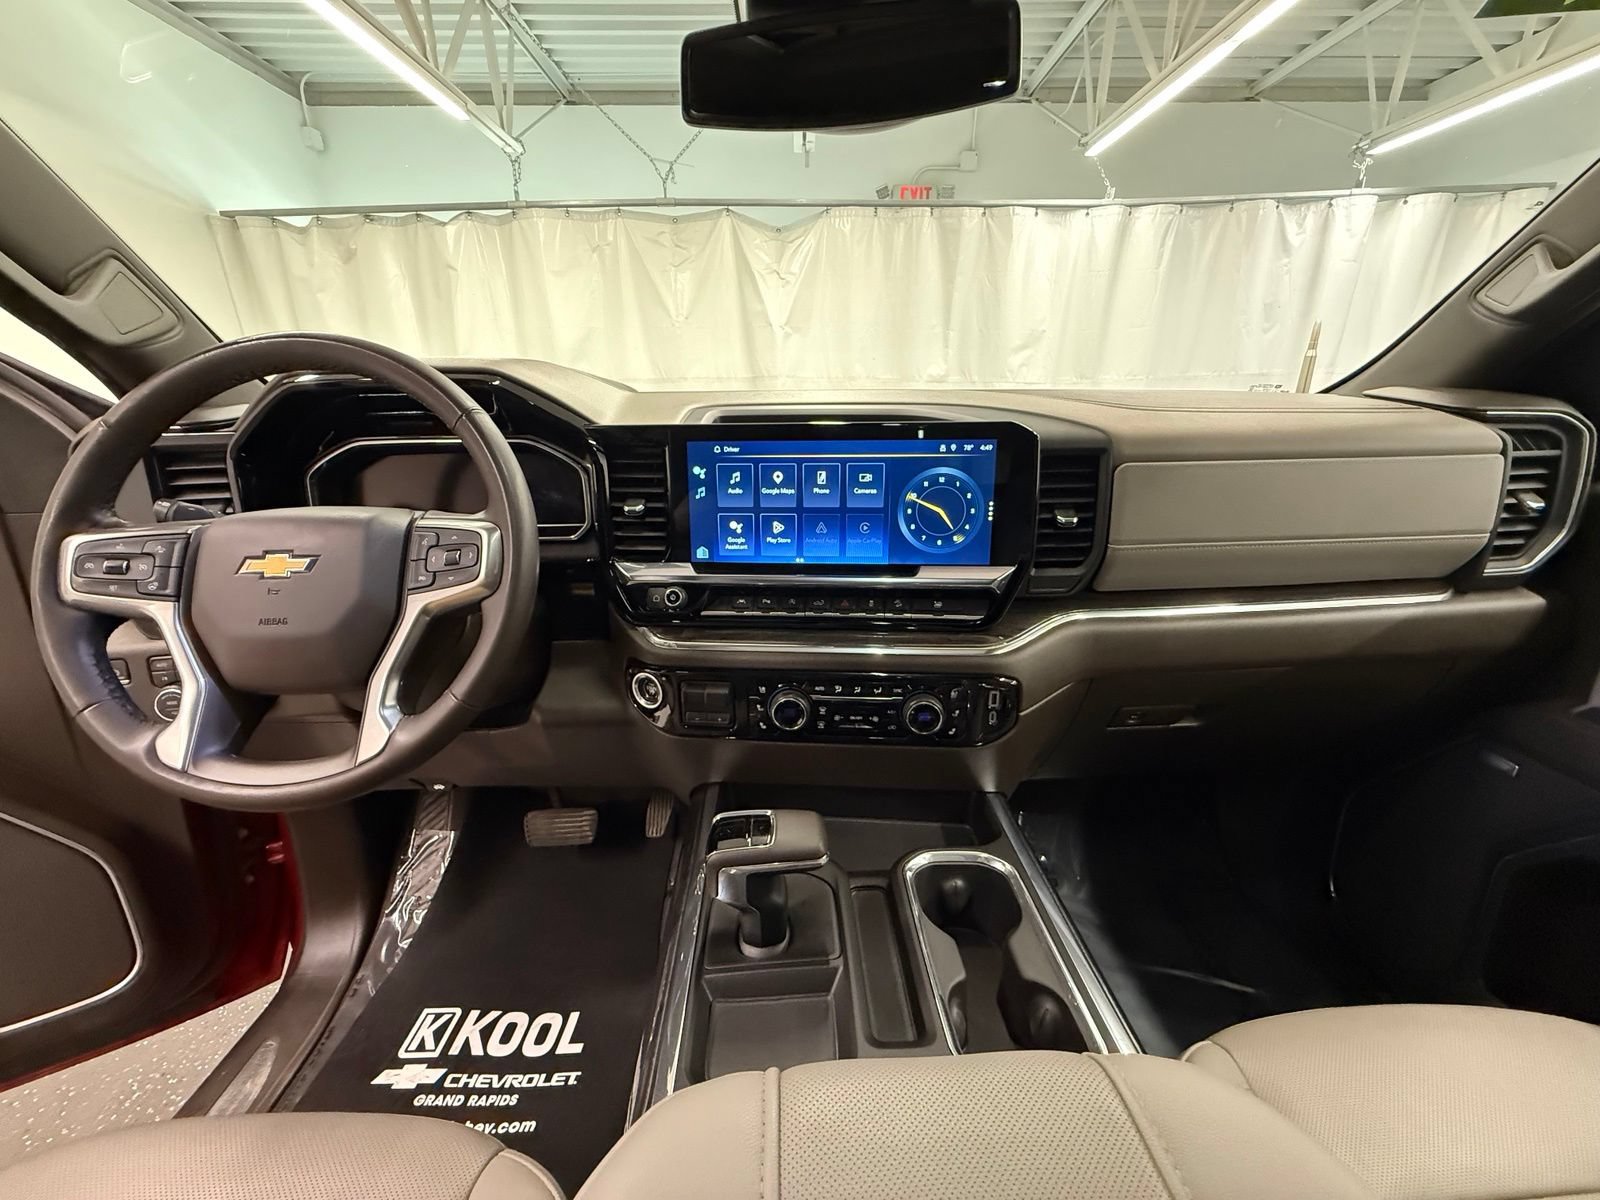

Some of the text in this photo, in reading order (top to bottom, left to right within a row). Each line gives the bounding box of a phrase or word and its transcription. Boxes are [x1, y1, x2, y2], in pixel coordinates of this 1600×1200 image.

[723, 445, 741, 454] Driver
[979, 443, 994, 452] 4:49
[727, 487, 744, 495] Audio
[761, 487, 796, 496] Google Maps
[813, 487, 831, 495] Phone
[853, 487, 878, 495] Cameras
[727, 536, 746, 545] Google
[766, 537, 778, 545] Play
[258, 617, 288, 626] AIRBAG
[448, 1009, 585, 1058] KOOL
[413, 1092, 520, 1107] GRAND RAPIDS
